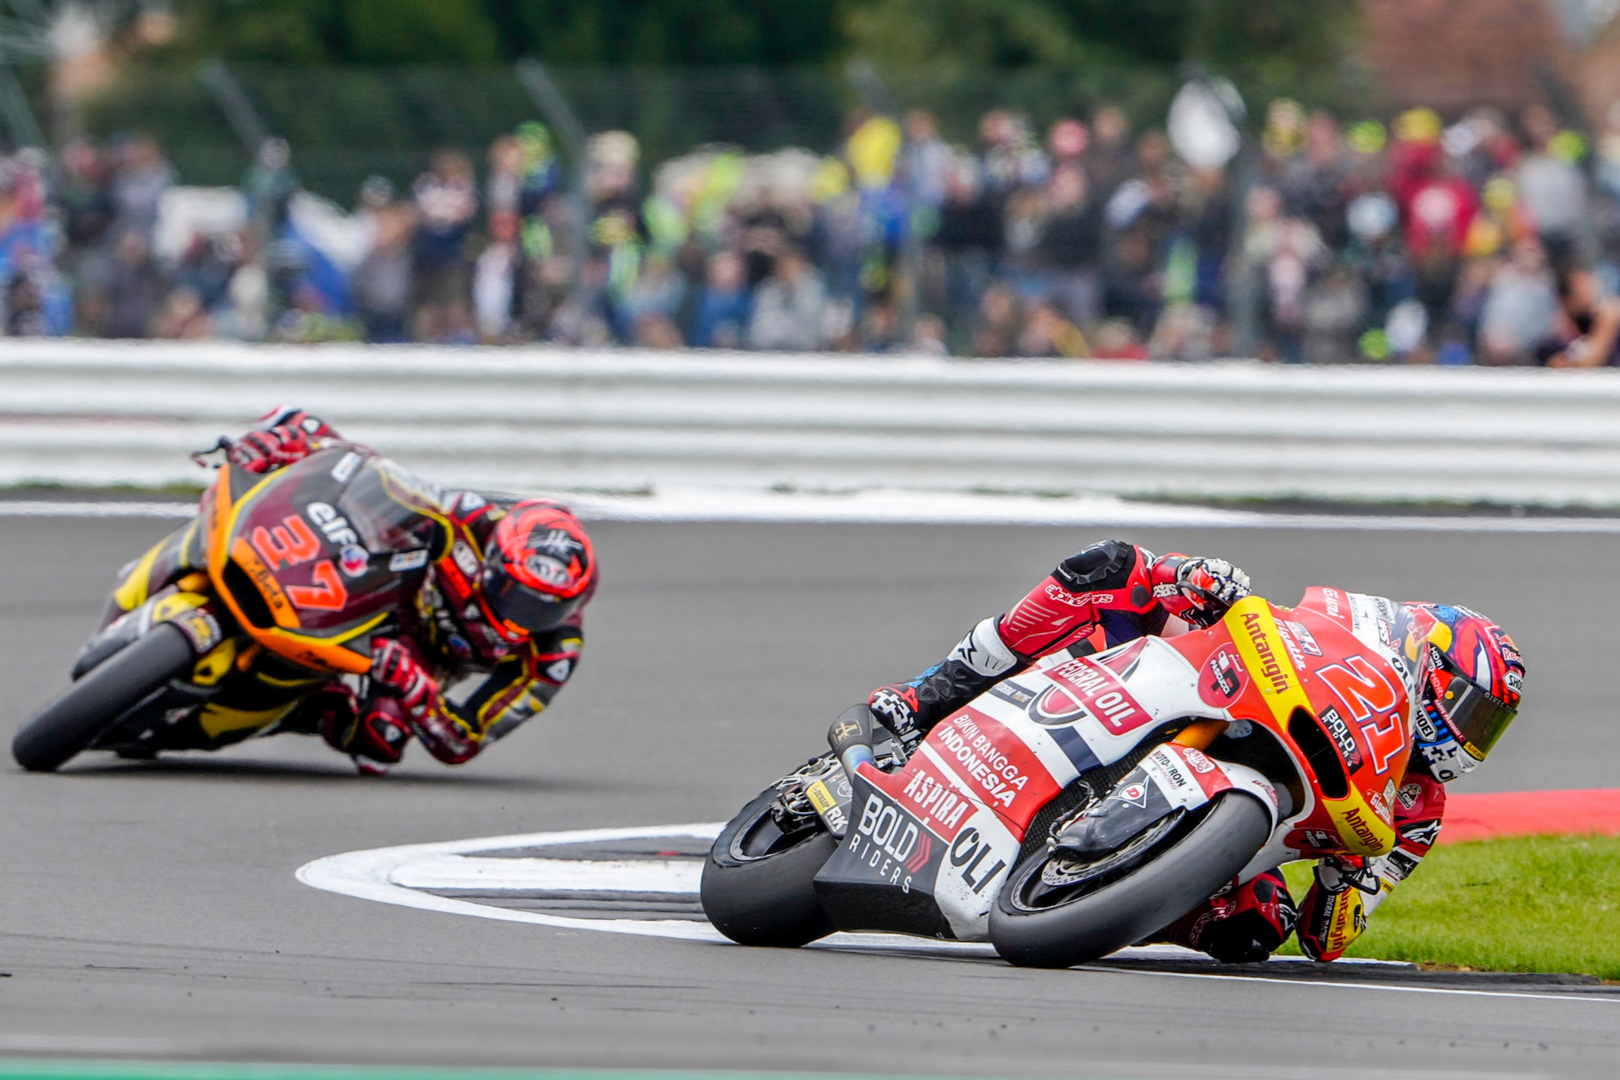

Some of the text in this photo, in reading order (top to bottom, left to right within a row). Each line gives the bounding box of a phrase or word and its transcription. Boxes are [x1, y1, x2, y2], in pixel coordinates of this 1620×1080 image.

[306, 502, 357, 546] elf
[252, 513, 348, 612] 37
[1210, 658, 1231, 695] PASCUCCI
[1240, 613, 1290, 694] Antangin
[1053, 659, 1136, 728] FEDERAL OIL
[1314, 653, 1406, 776] 21
[1416, 708, 1434, 738] HOEI
[953, 713, 1029, 791] BIKIN BANGGA
[1321, 715, 1353, 768] RIDERS
[1326, 708, 1356, 752] BOLD
[938, 725, 1017, 809] INDONESIA
[826, 805, 849, 830] RK
[858, 793, 918, 864] BOLD
[903, 770, 969, 829] ASPIRA
[1342, 807, 1384, 852] Antangin
[849, 834, 912, 895] RIDERS
[949, 826, 1007, 895] OLI
